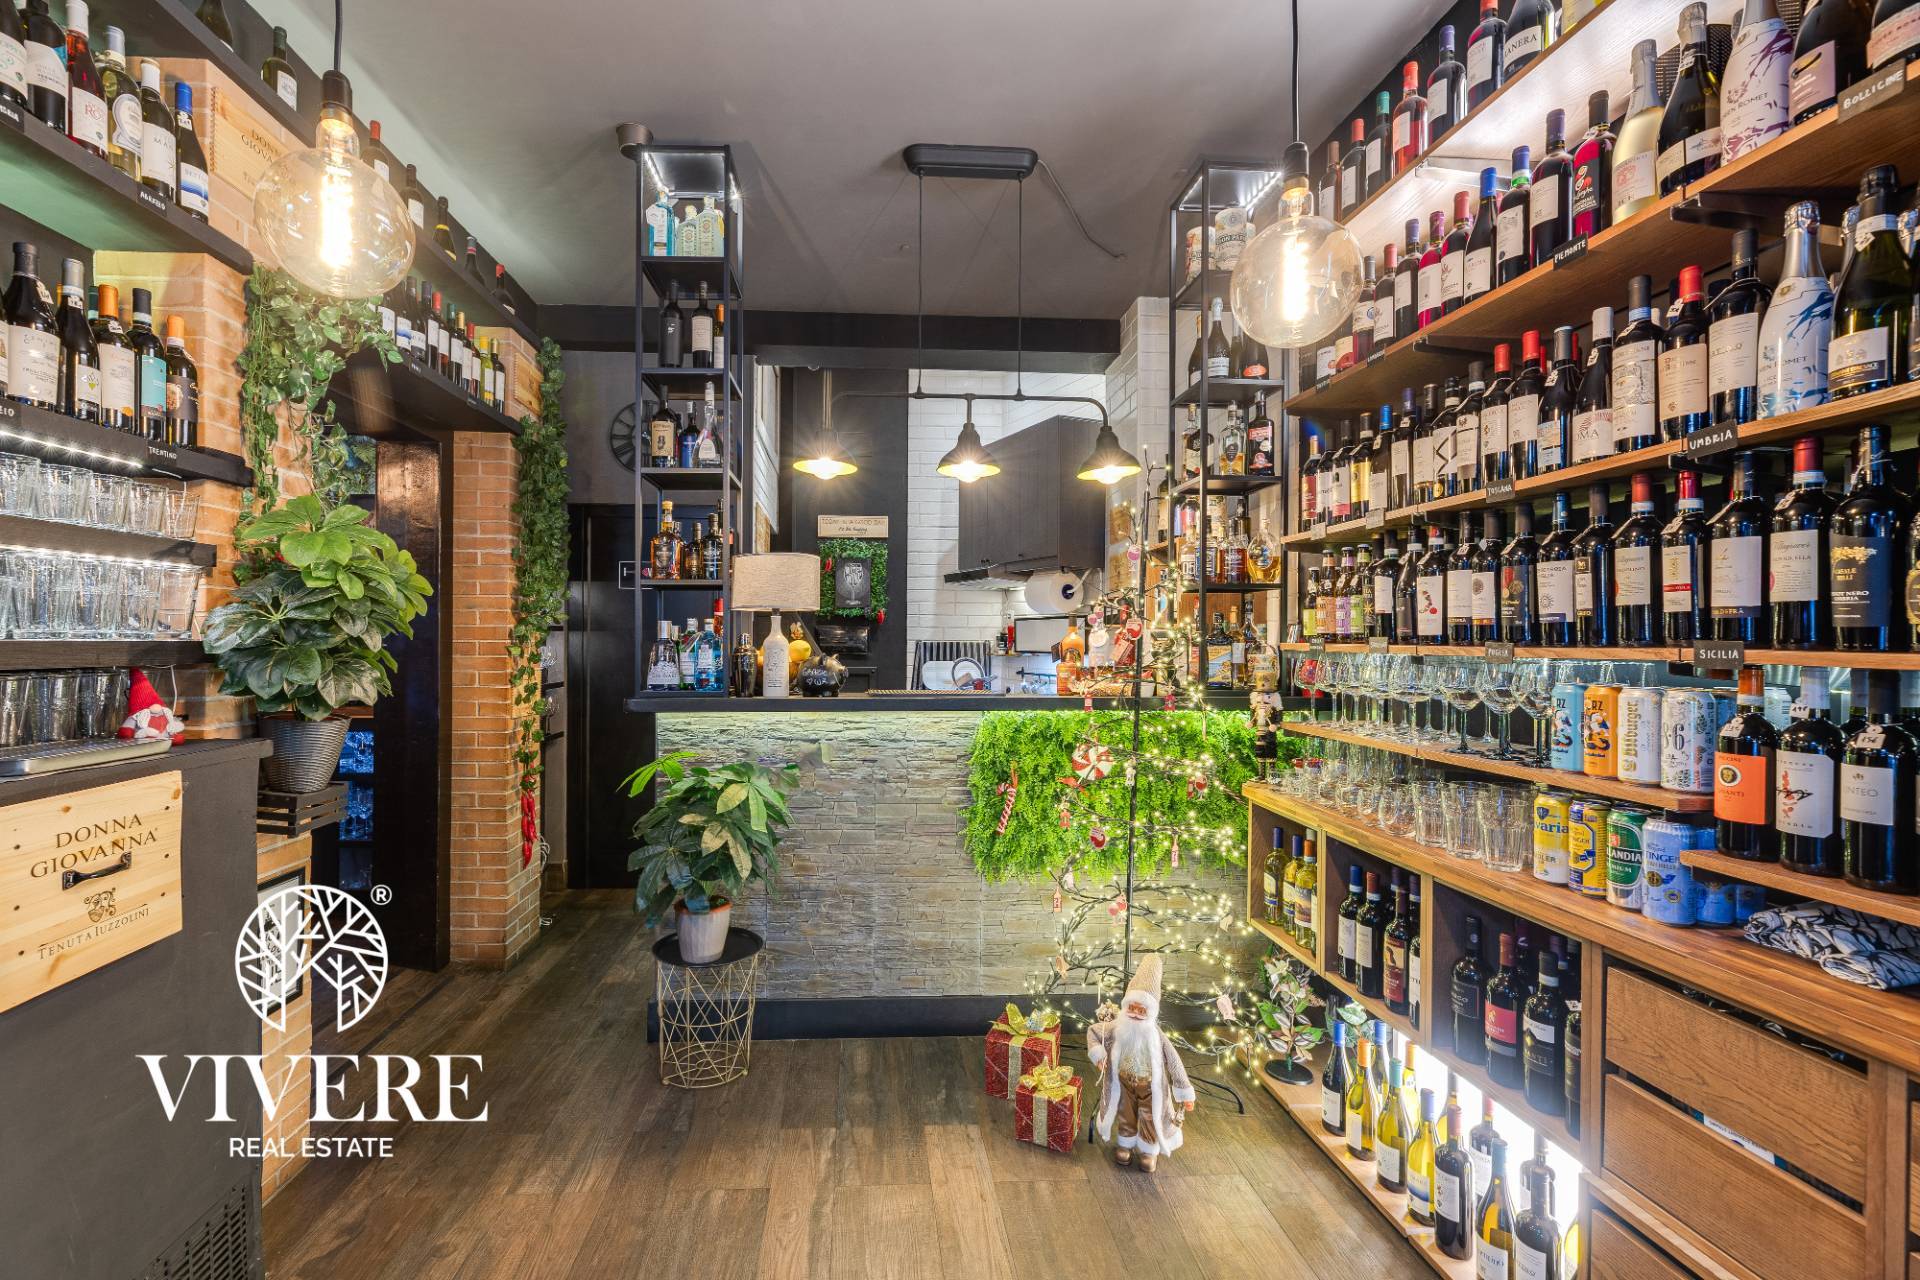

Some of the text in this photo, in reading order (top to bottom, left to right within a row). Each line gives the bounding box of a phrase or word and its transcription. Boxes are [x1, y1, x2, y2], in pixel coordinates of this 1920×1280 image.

[1554, 239, 1586, 263] PIEMONTE
[1689, 430, 1733, 450] UMBRIA
[148, 446, 178, 460] TRENTINO
[1699, 649, 1740, 659] SICILIA
[55, 813, 143, 849] DONNA
[30, 828, 158, 880] GIOVANNA
[38, 908, 150, 961] TENUTA IUZZOLINI
